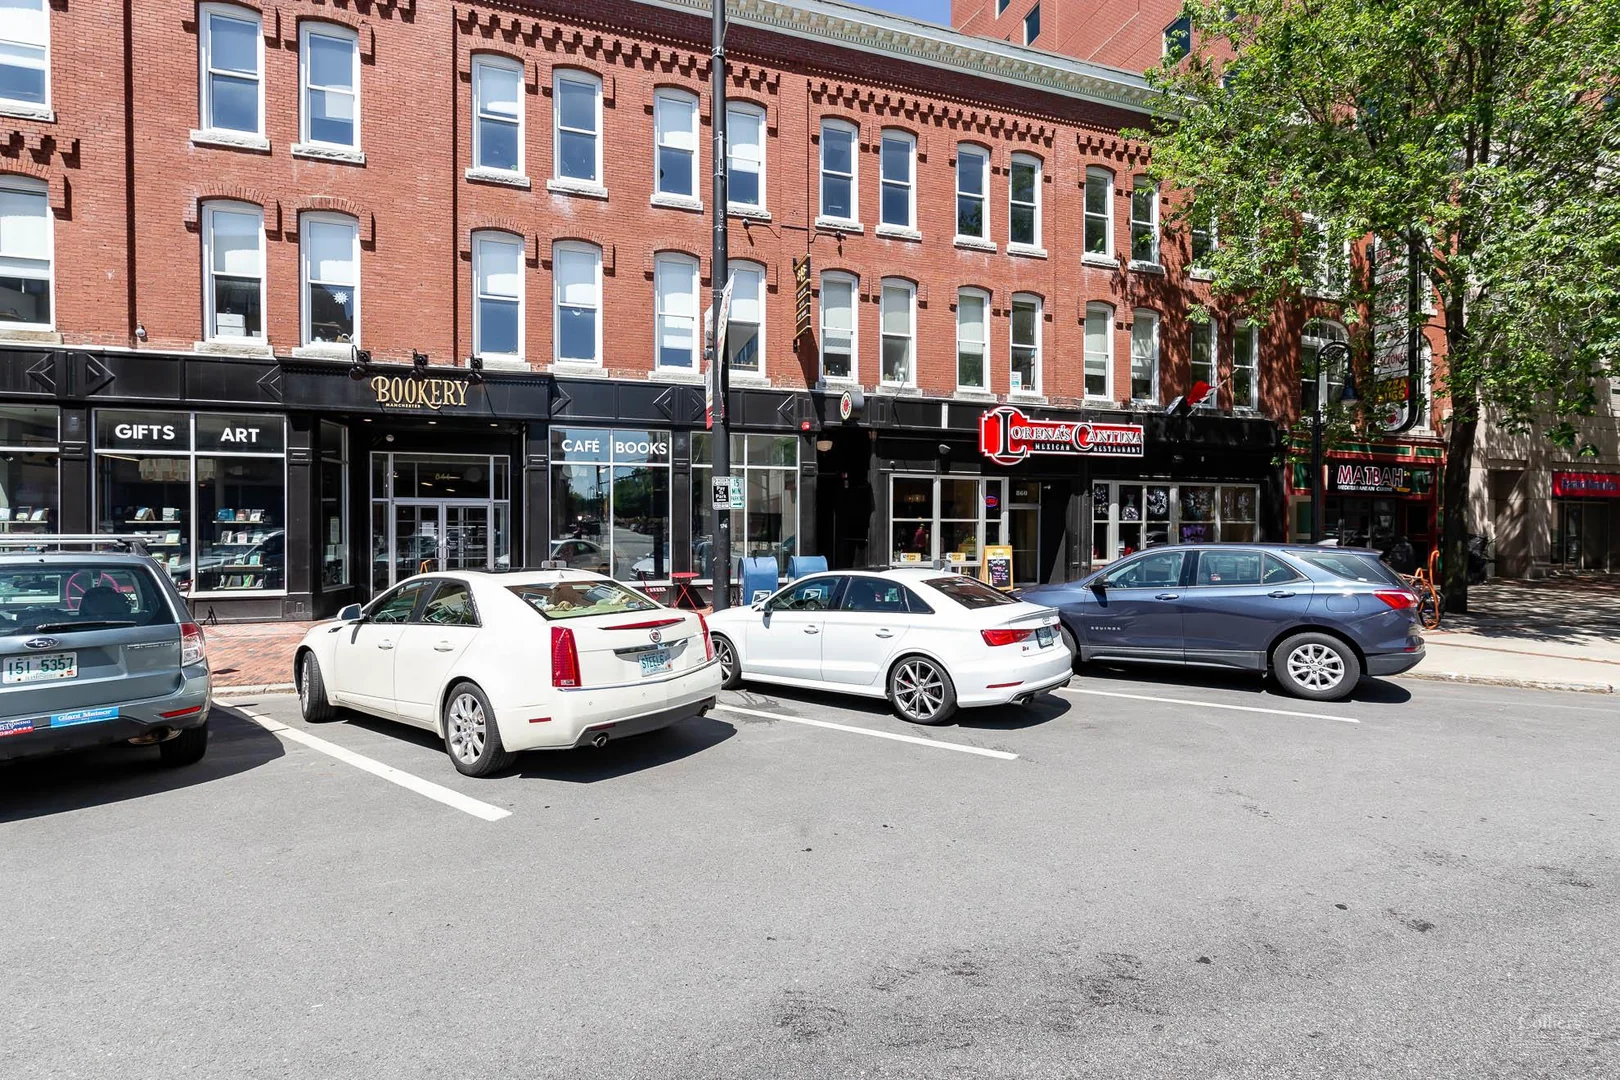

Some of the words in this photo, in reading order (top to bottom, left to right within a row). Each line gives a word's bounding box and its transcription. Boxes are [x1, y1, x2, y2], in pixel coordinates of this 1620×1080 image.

[371, 376, 469, 409] BOOKERY
[115, 424, 175, 440] GIFTS
[220, 427, 260, 443] ART
[994, 410, 1071, 458] LORENA'S
[1071, 423, 1142, 451] CANTINA
[561, 438, 600, 453] CAFÉ
[615, 441, 667, 455] BOOKS
[1034, 443, 1070, 451] MEXICAN
[733, 479, 740, 487] 15
[1337, 465, 1404, 487] MATBAH
[9, 661, 30, 675] 151
[41, 657, 74, 673] 5357
[58, 712, 81, 721] Giant
[82, 709, 112, 718] Meteor
